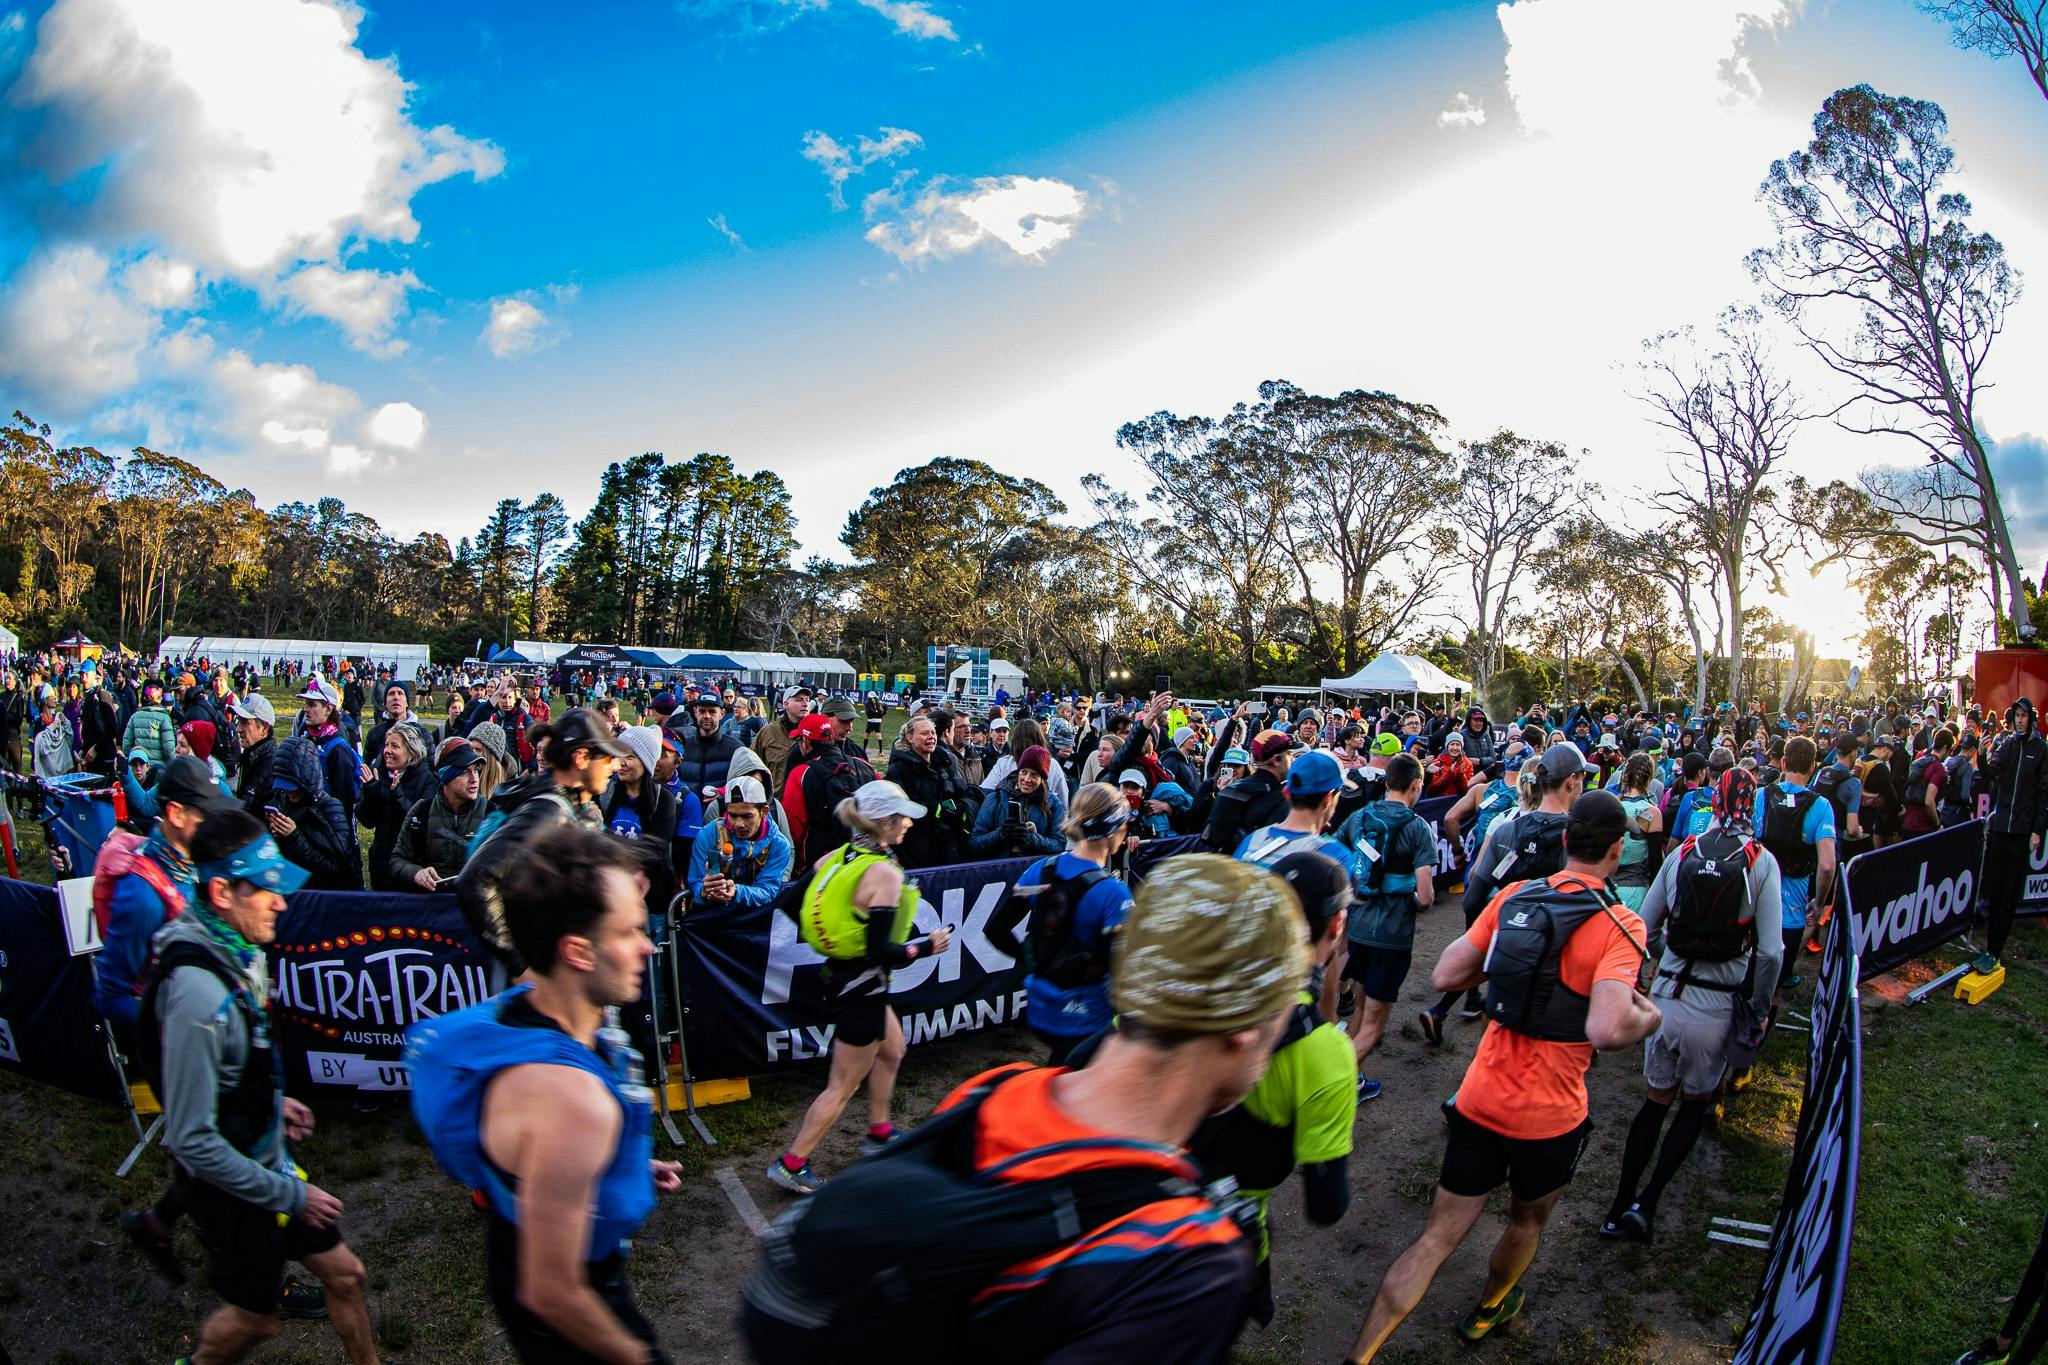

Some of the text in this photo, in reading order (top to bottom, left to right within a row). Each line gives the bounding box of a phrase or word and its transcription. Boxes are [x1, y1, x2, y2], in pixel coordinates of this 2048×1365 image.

[811, 889, 835, 951] ATHAN
[1852, 861, 1973, 958] wahoo
[762, 881, 1032, 1005] HOK
[343, 1030, 409, 1046] AUSTRAL
[766, 1023, 836, 1062] FLY
[902, 995, 1005, 1046] UMAN
[321, 1058, 411, 1086] BY UT
